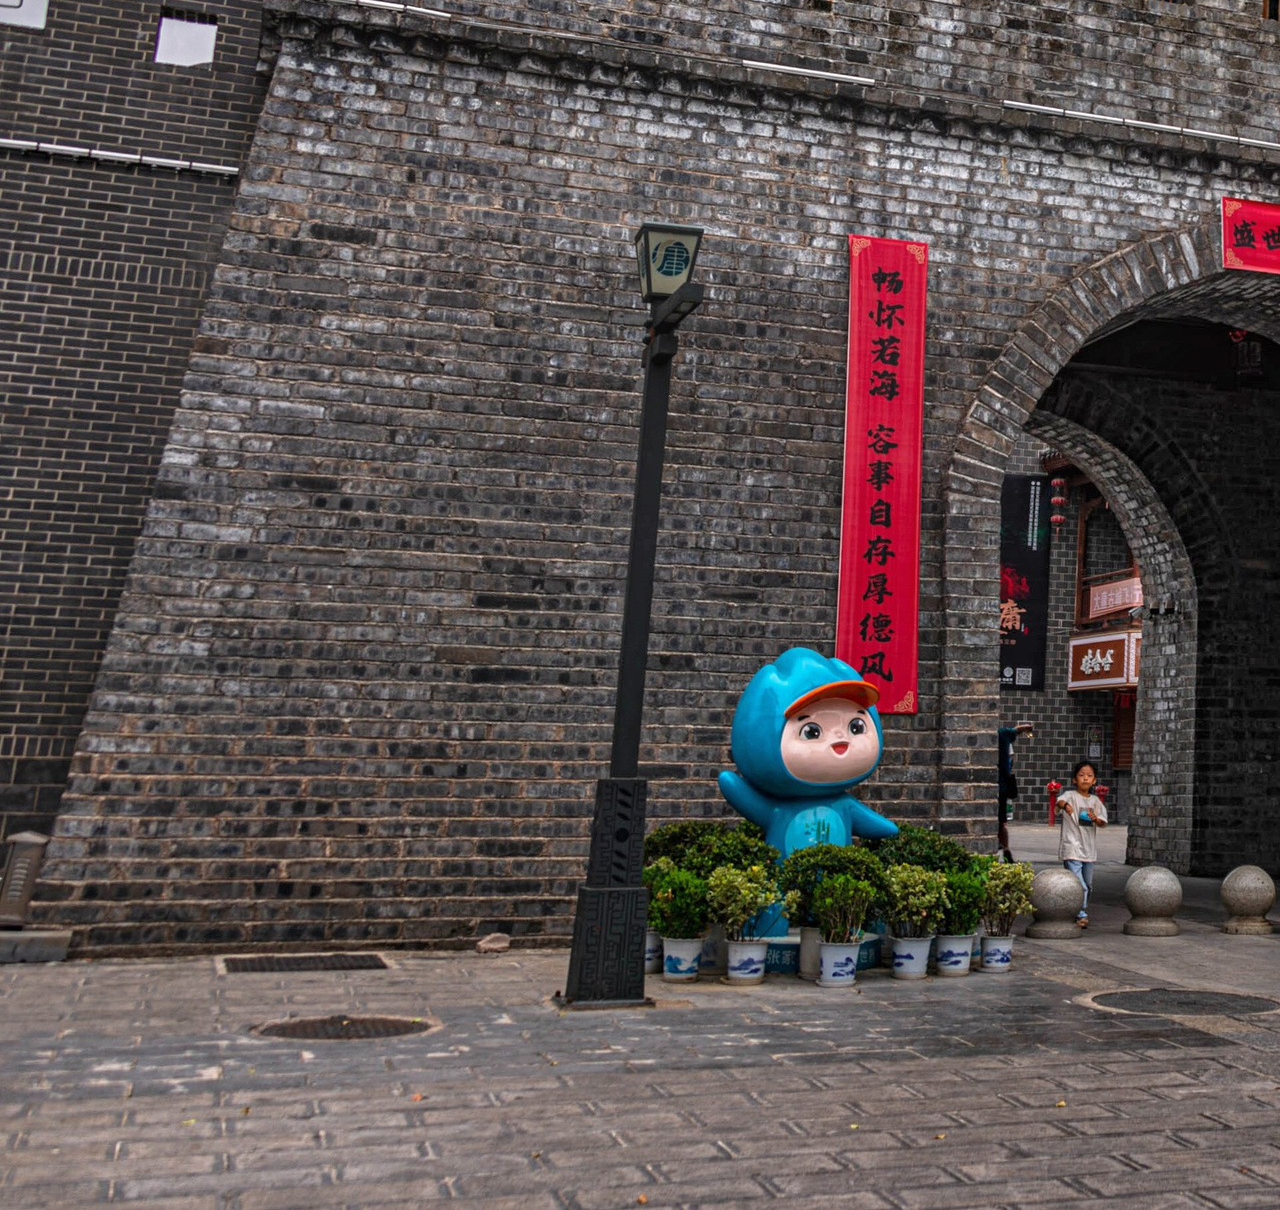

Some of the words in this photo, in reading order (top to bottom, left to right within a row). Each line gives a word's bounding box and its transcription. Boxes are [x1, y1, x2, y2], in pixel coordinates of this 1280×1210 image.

[868, 266, 905, 401] 畅怀若海
[766, 949, 796, 965] 张家
